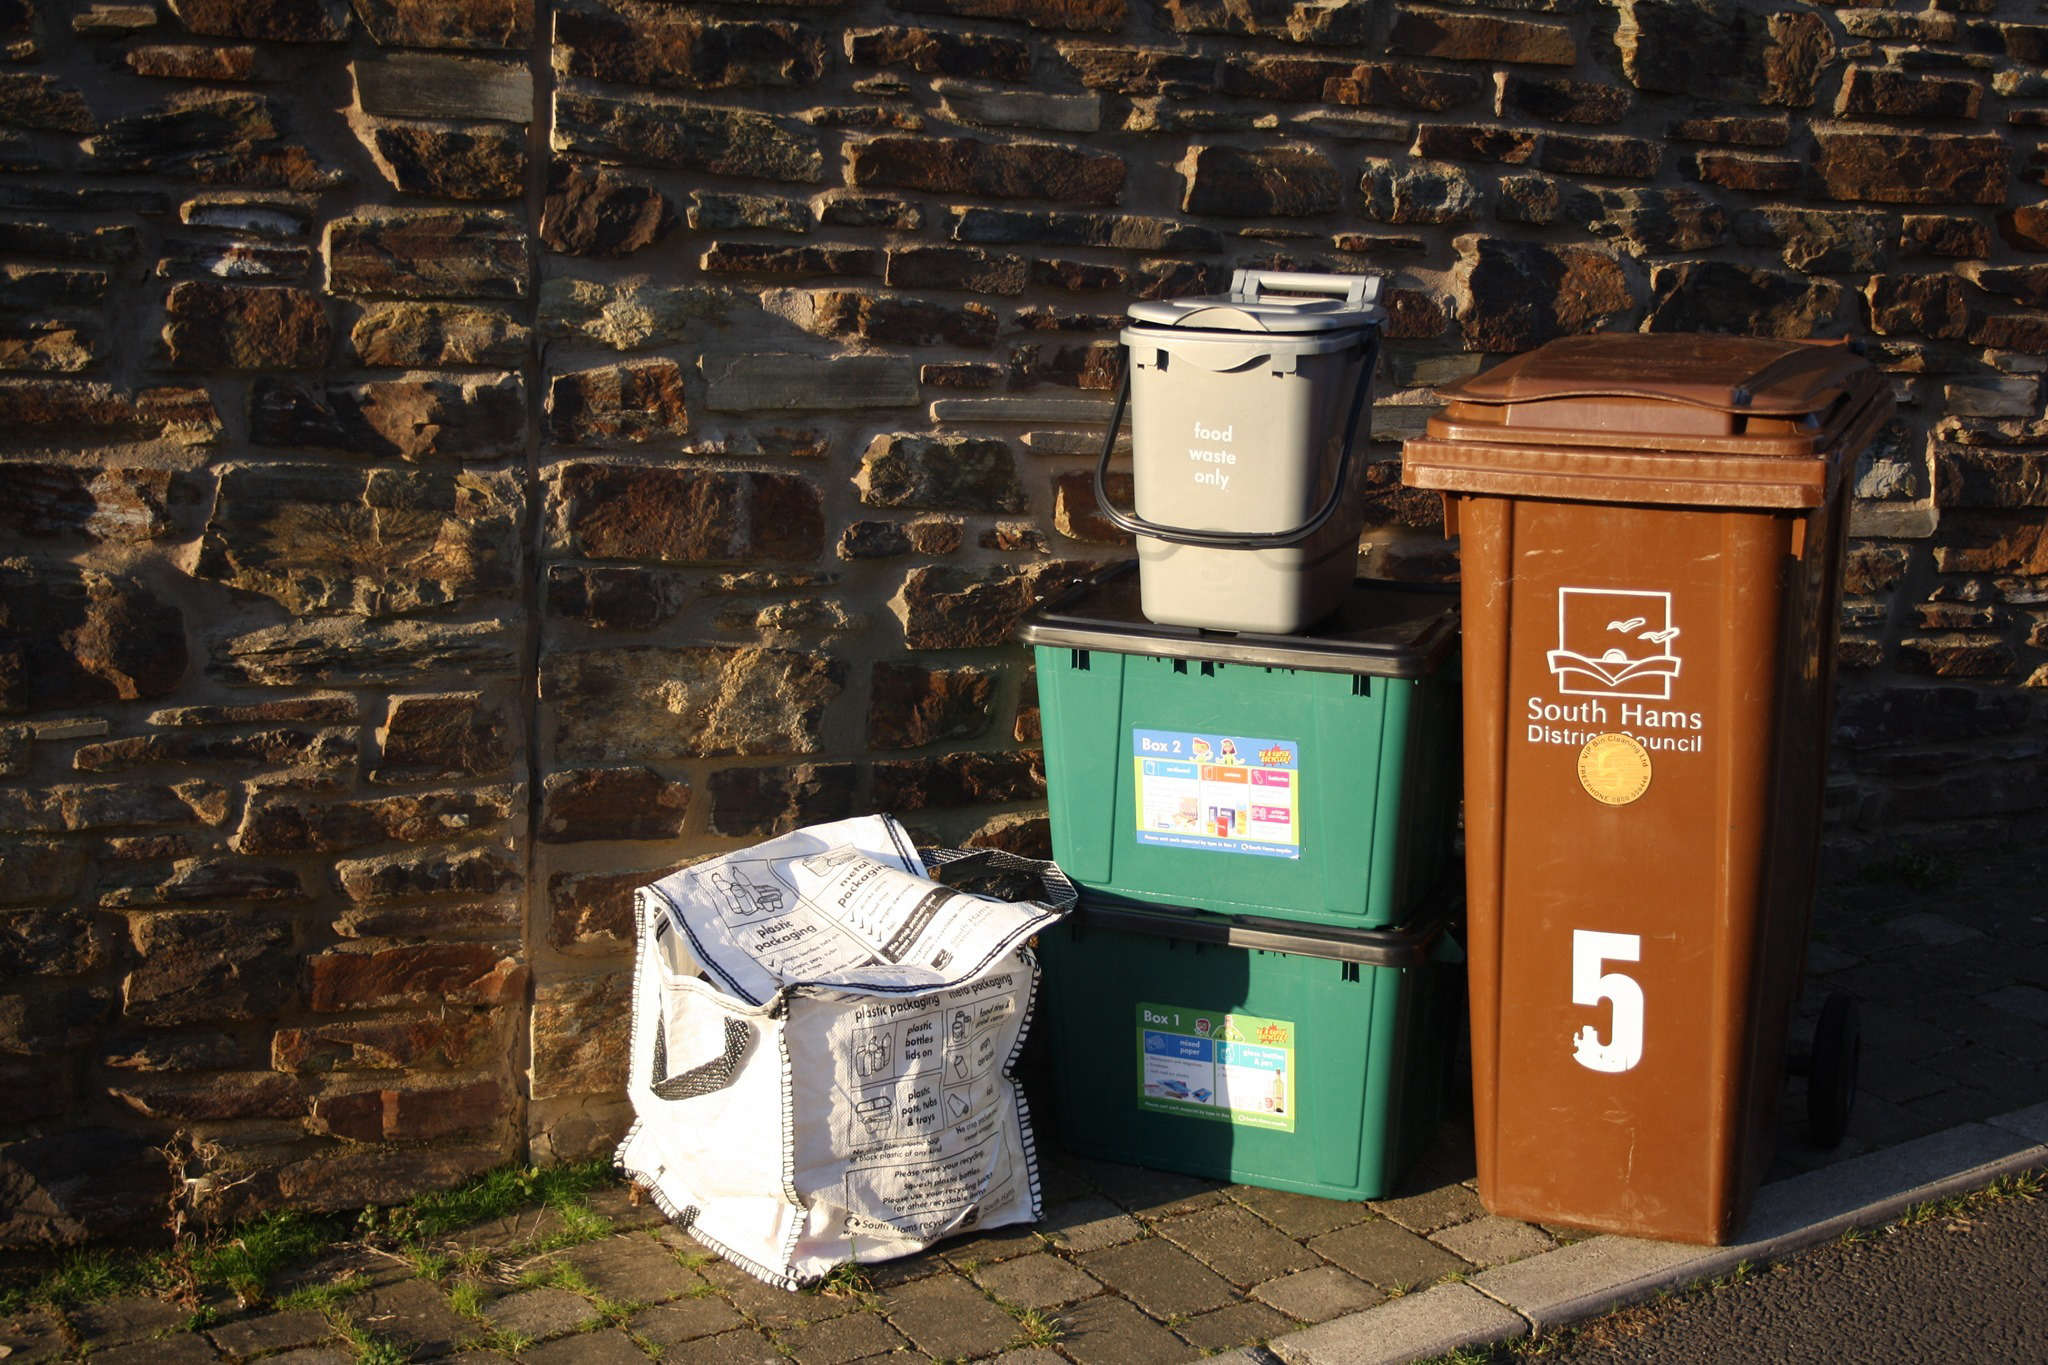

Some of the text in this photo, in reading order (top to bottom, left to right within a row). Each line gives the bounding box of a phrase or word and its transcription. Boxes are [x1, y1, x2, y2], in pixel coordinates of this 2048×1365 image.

[1194, 421, 1232, 442] food
[1189, 447, 1236, 465] waste
[1194, 469, 1230, 490] only
[1527, 697, 1702, 730] South Hams
[1142, 737, 1181, 753] Box 2
[1527, 725, 1702, 752] Distric ouncil
[1639, 754, 1649, 767] Ltd
[840, 861, 871, 887] metal
[838, 865, 896, 908] packagin
[757, 919, 794, 938] plastic
[755, 925, 817, 952] packaging
[971, 974, 1013, 996] packaging
[855, 994, 940, 1022] plastic packaging
[1572, 929, 1644, 1073] 5
[1143, 1010, 1180, 1026] Box 1
[907, 1020, 932, 1036] plastic
[905, 1035, 933, 1048] bottles
[1180, 1040, 1200, 1048] mixed
[905, 1048, 933, 1061] lids on
[1180, 1048, 1200, 1056] paper
[908, 1087, 930, 1101] plastic
[916, 1113, 936, 1126] trays
[894, 1170, 919, 1178] Please
